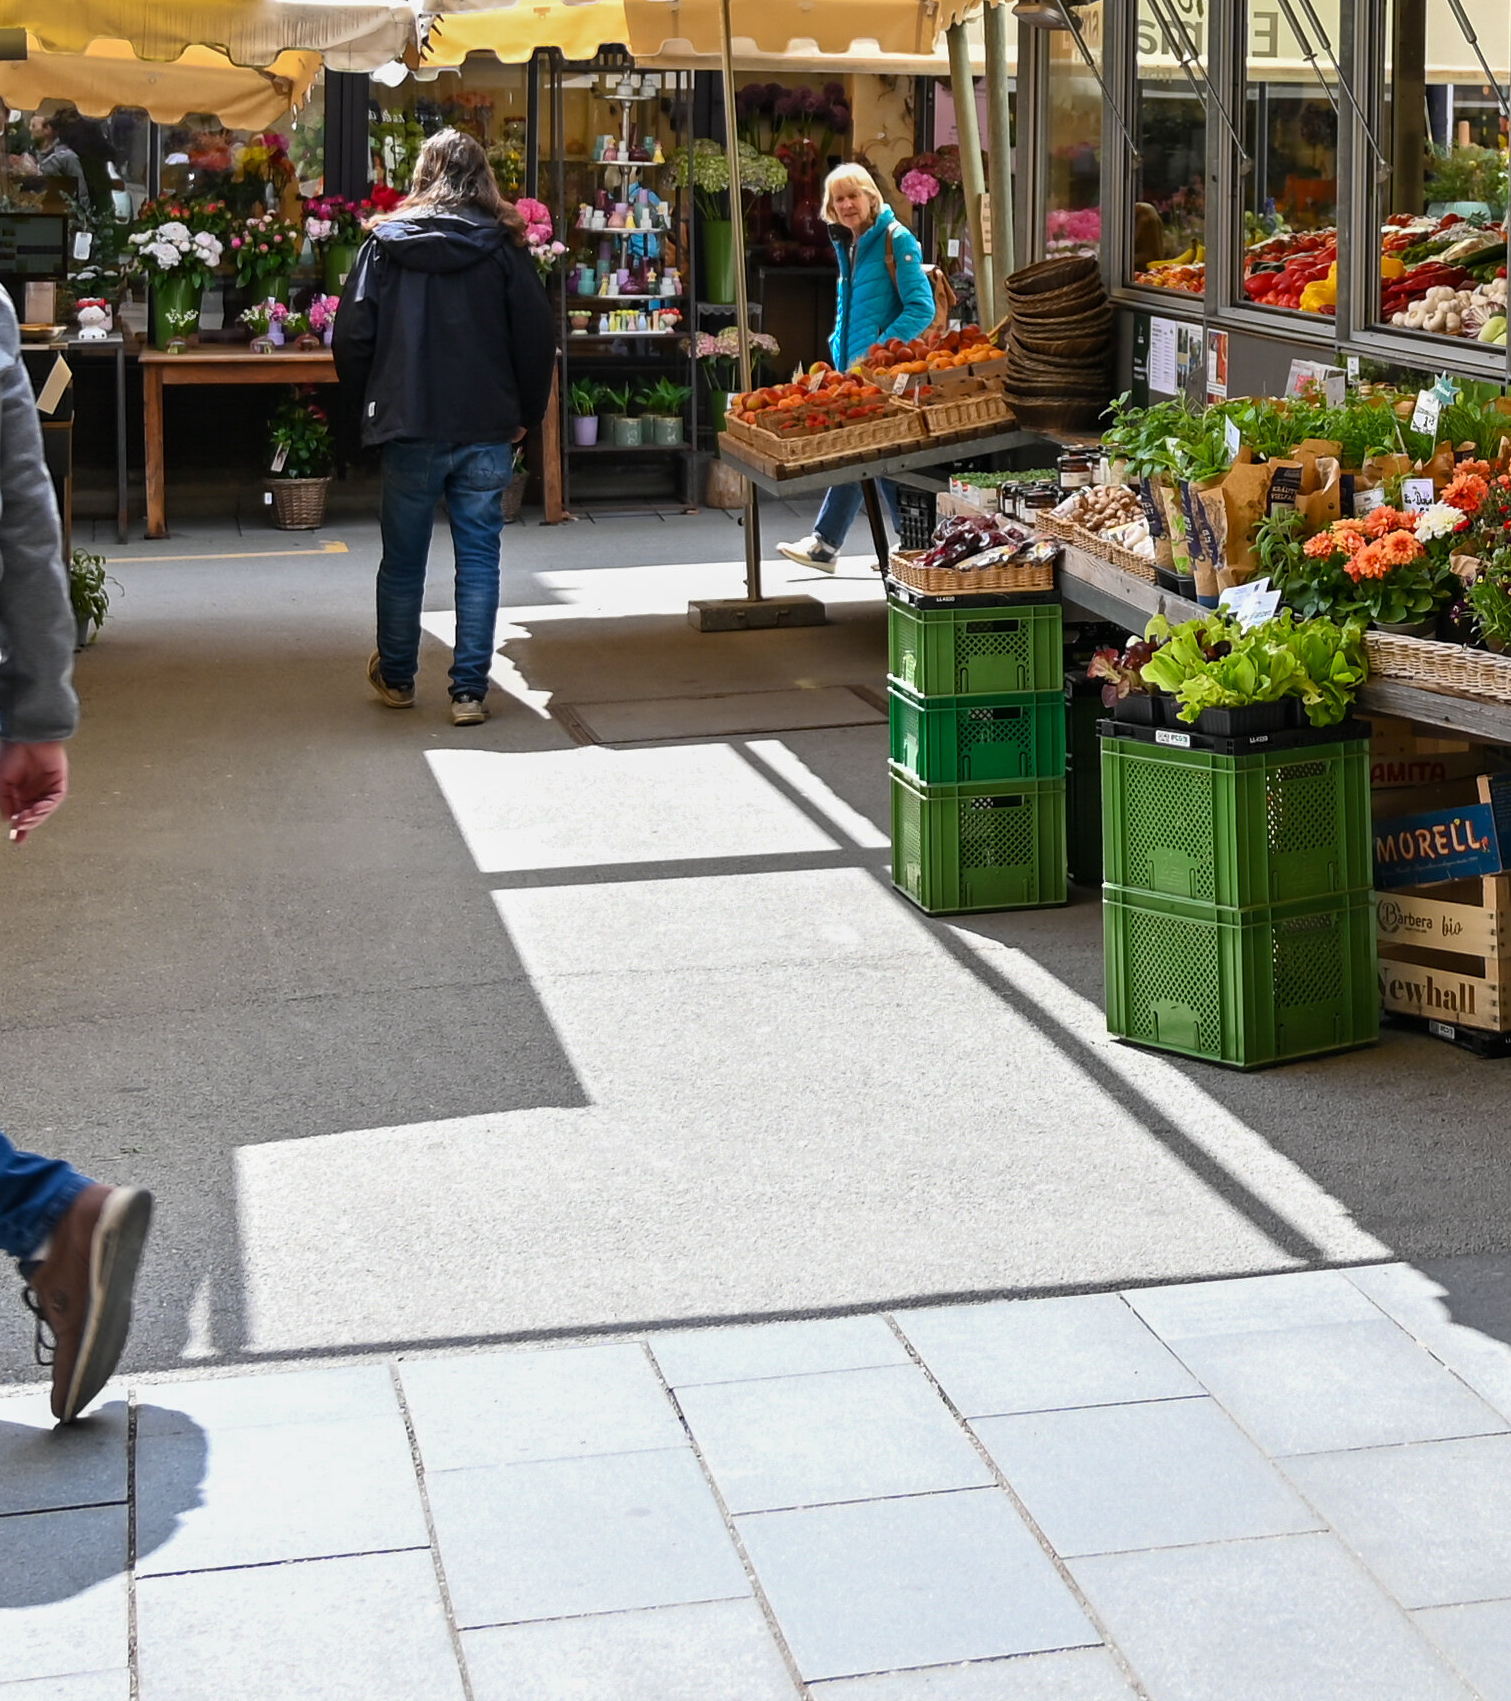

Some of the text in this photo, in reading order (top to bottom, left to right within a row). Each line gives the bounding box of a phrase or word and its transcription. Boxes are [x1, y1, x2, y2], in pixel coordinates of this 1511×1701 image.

[1371, 761, 1447, 784] AMITA
[1375, 818, 1483, 864] MORELL
[1381, 903, 1464, 937] Barbera bio
[1376, 968, 1477, 1015] Newhall
